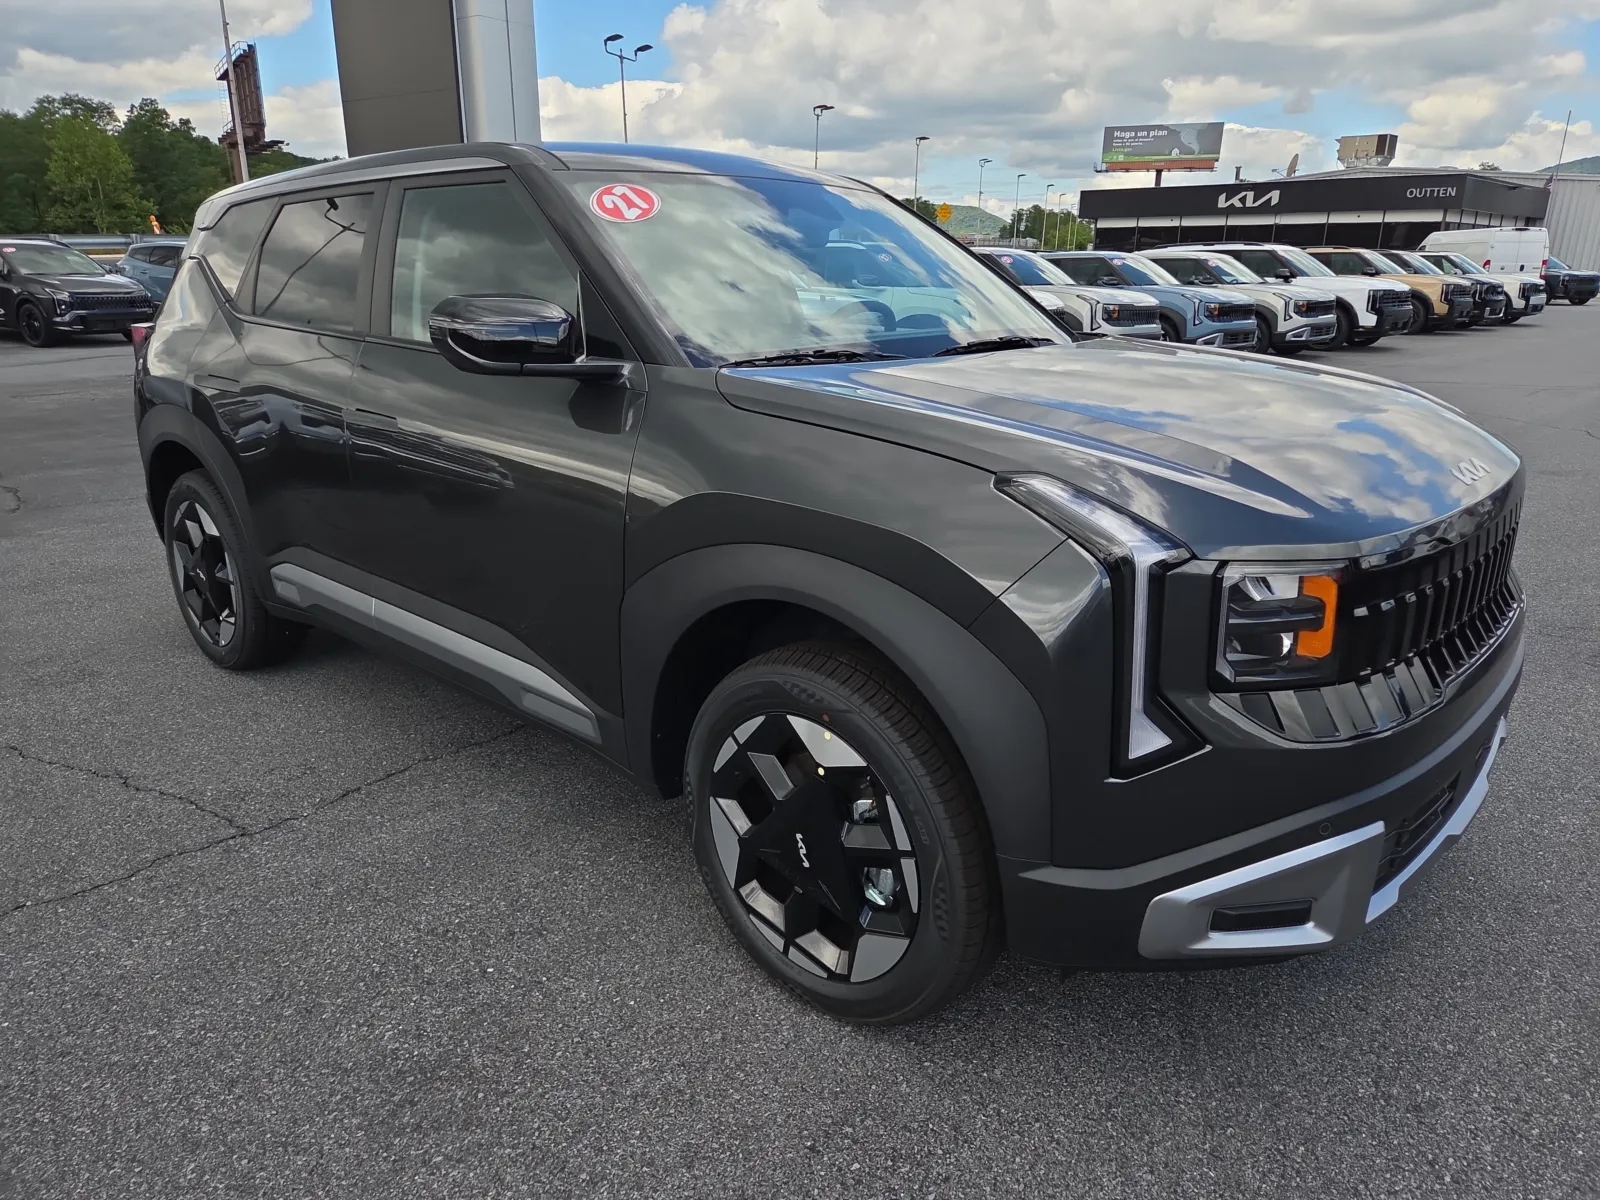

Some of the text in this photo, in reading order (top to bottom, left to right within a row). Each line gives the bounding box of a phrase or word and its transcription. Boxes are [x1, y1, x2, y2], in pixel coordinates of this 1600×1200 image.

[1114, 130, 1135, 138] Haga
[1150, 129, 1167, 137] plan
[1218, 190, 1280, 208] KIA
[1406, 187, 1457, 198] OUTTEN
[1449, 457, 1491, 486] KIA
